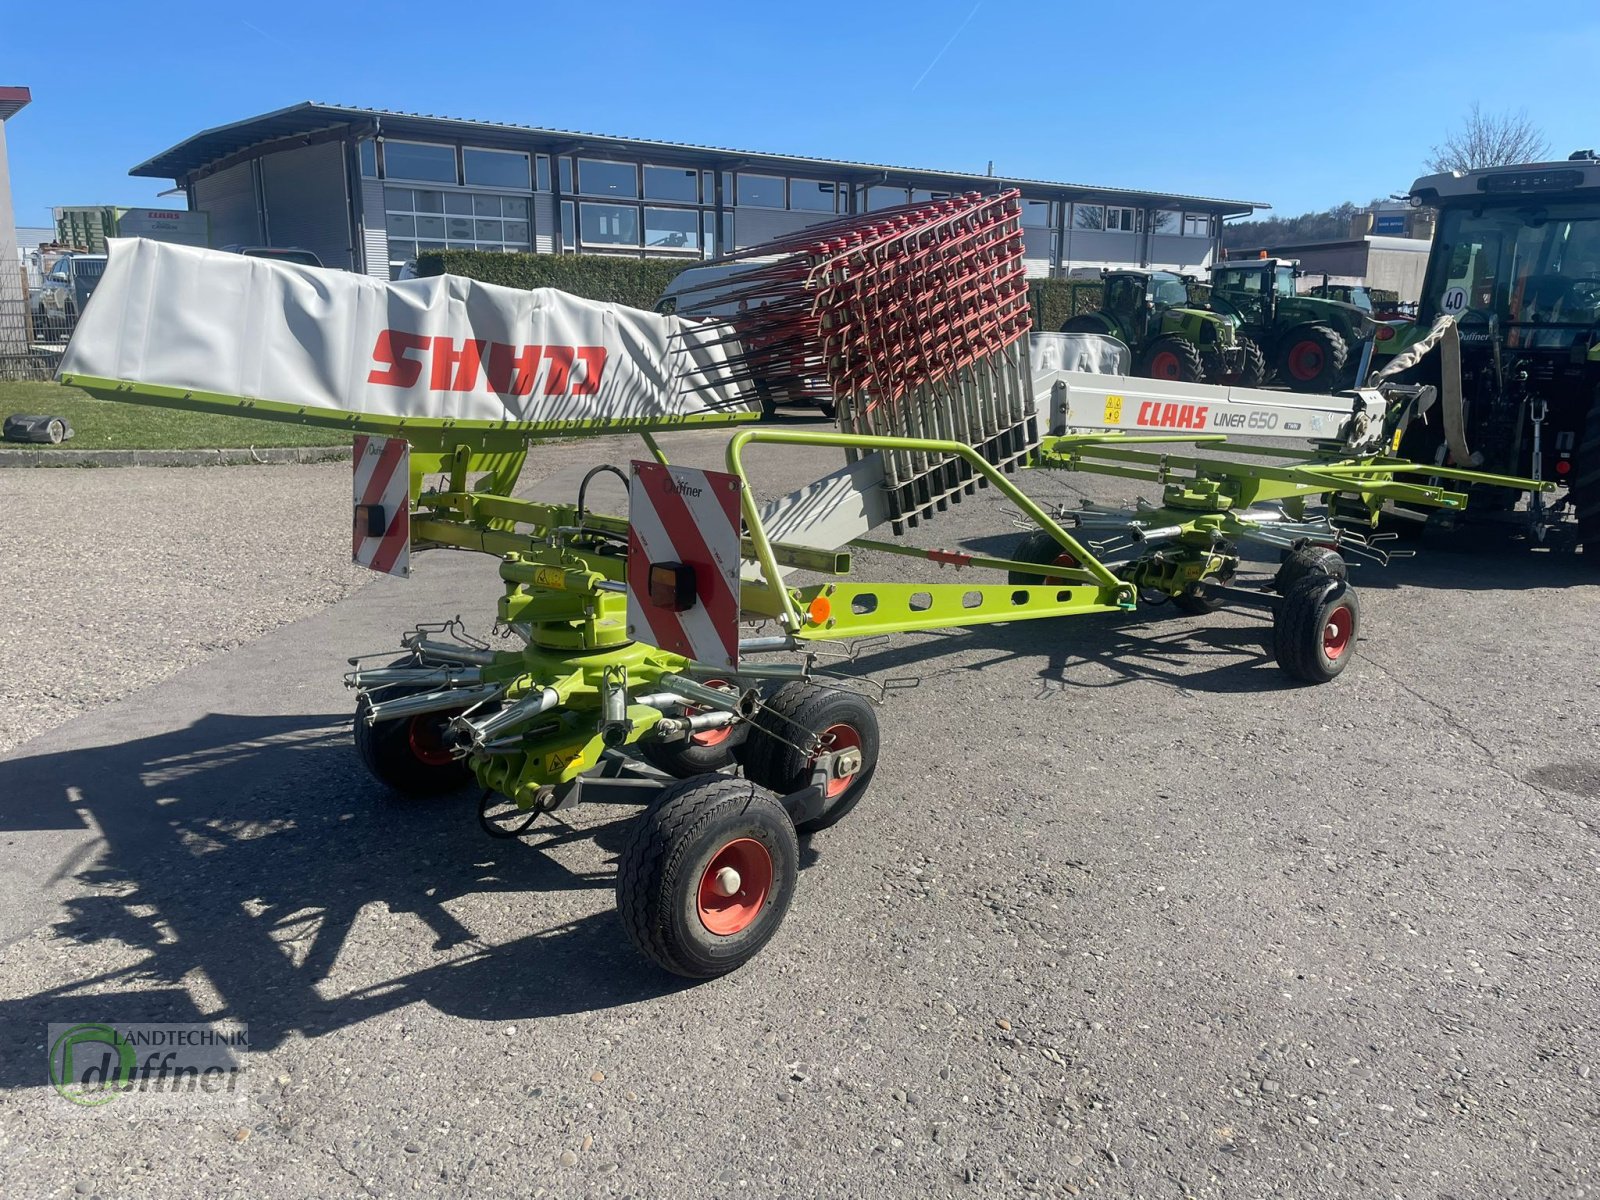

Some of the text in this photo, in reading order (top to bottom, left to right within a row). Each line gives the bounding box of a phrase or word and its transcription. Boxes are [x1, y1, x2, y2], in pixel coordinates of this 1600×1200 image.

[1446, 291, 1463, 310] 40
[367, 329, 607, 396] CLAAS
[1136, 401, 1208, 429] CLAAS
[1213, 412, 1246, 428] LINER
[1247, 411, 1278, 430] 650
